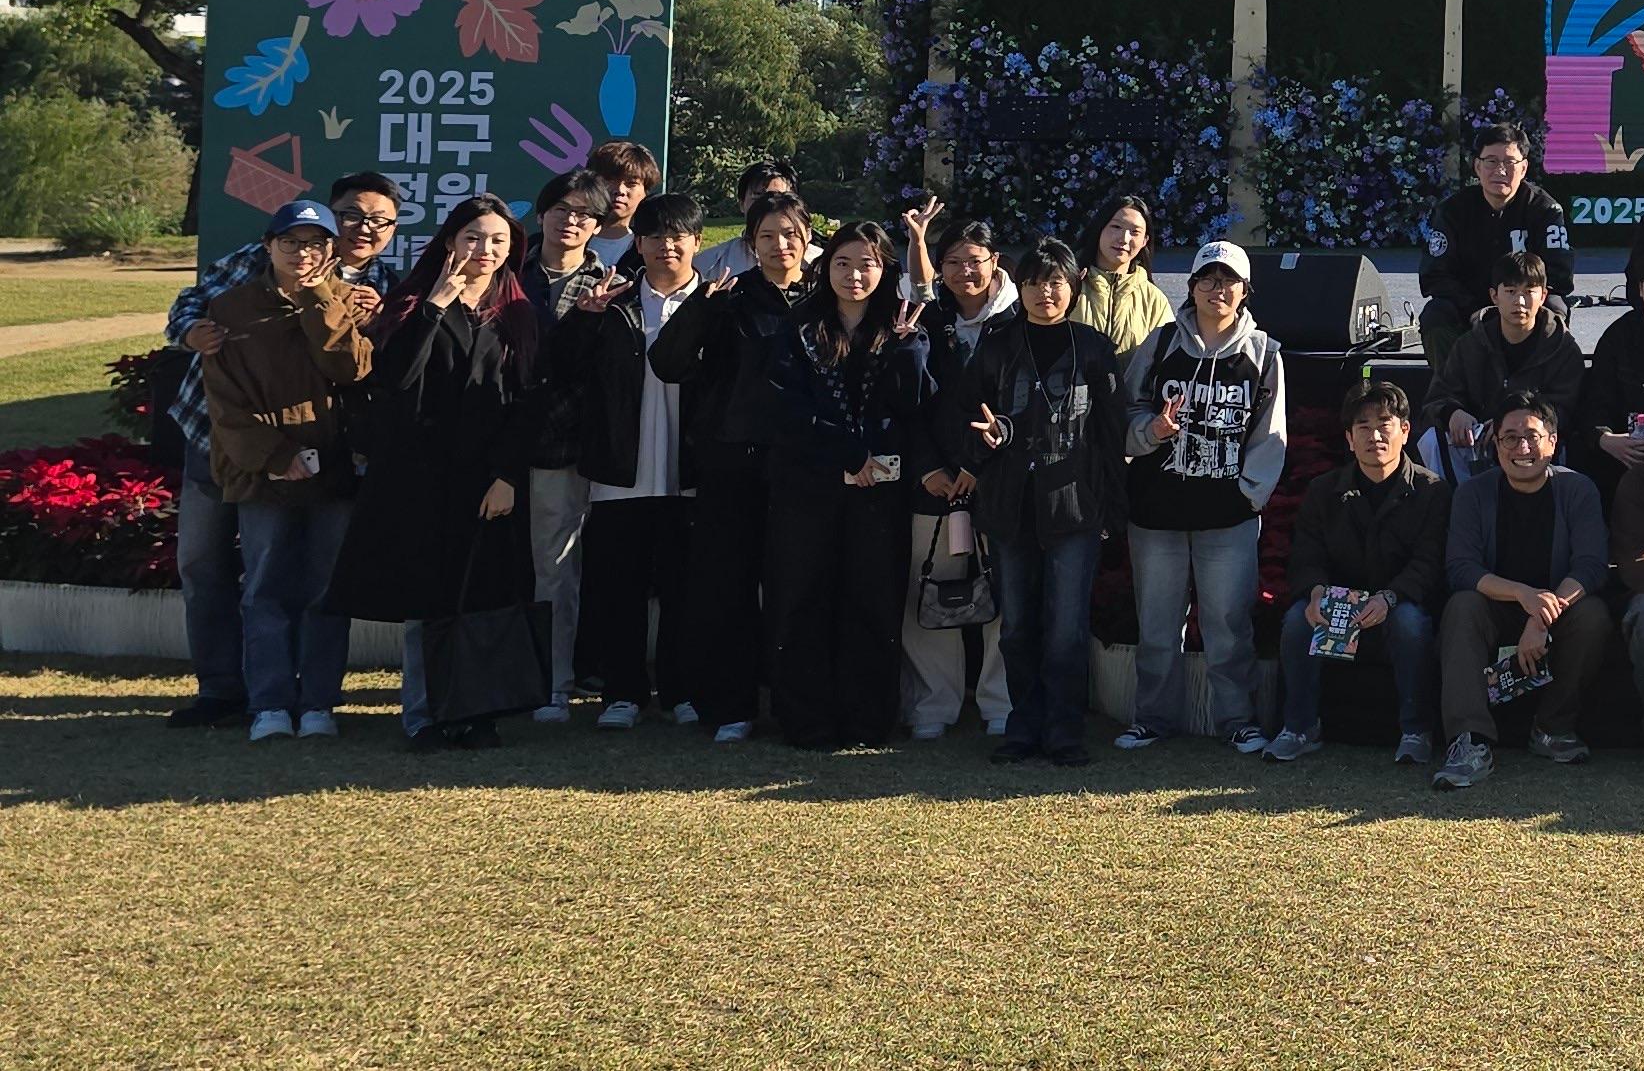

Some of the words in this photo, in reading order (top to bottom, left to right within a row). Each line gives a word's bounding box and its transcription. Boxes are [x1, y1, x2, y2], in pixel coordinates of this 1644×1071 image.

[378, 69, 495, 106] 2025
[378, 112, 492, 166] 대구
[1546, 224, 1570, 250] 22
